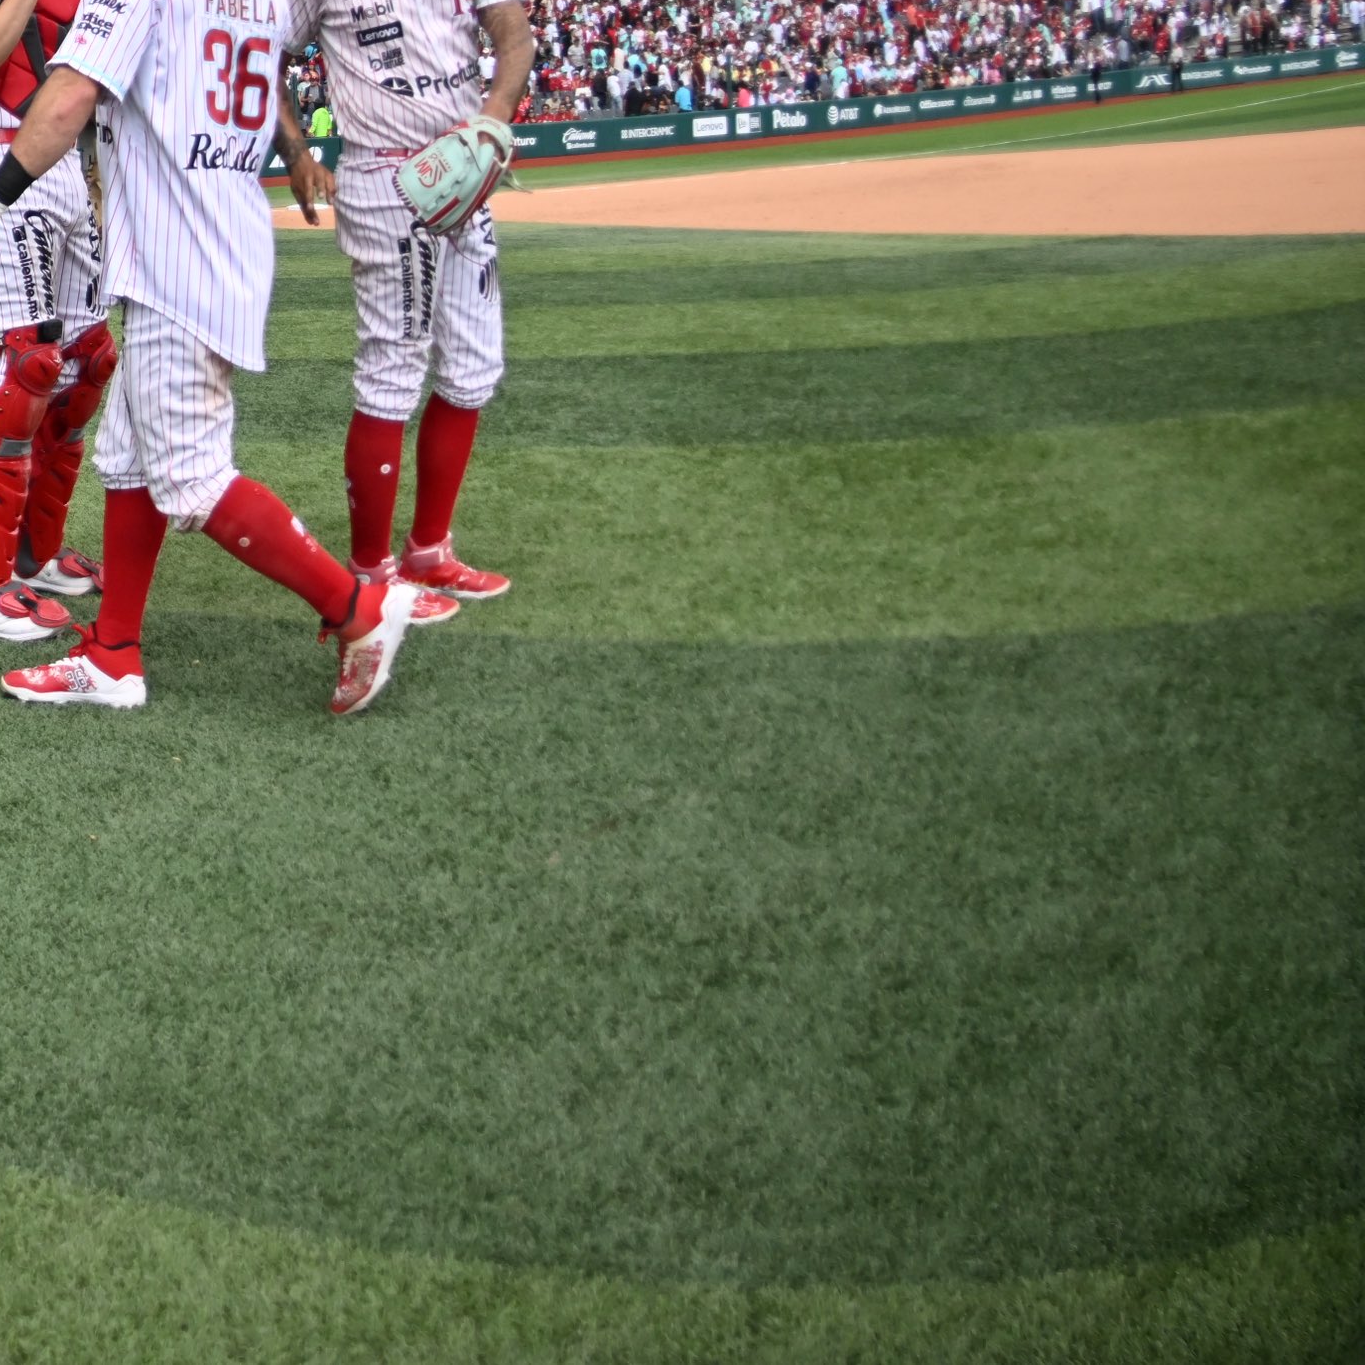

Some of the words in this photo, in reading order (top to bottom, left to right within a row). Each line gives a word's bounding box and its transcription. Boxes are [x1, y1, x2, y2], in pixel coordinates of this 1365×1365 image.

[358, 26, 399, 43] Lenovo
[203, 28, 271, 132] 36
[772, 109, 807, 130] Pétalo
[840, 107, 860, 120] AT&T
[628, 125, 675, 138] INTERCERAMIC
[696, 120, 724, 132] Lenovo
[17, 241, 40, 321] caliente.mx
[400, 255, 415, 338] caliente.mx
